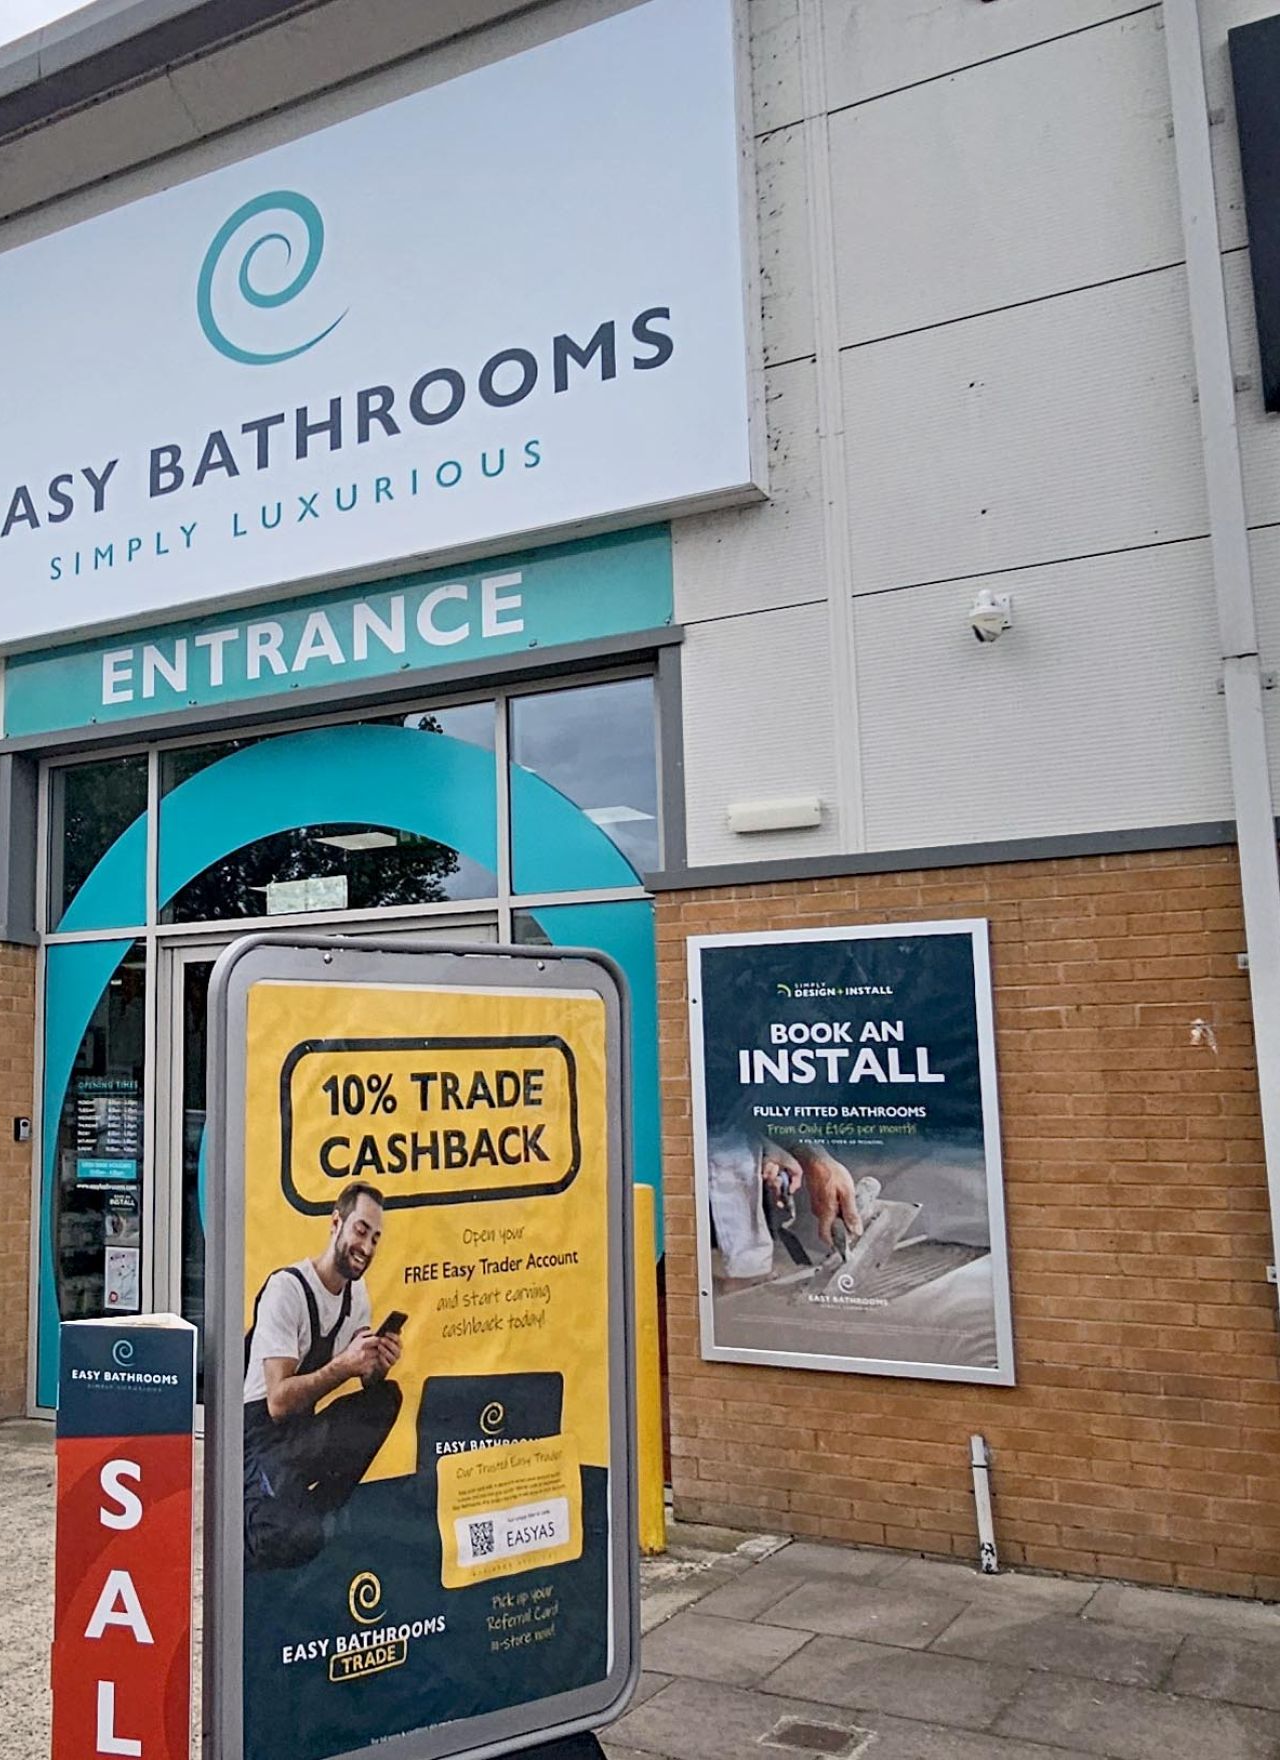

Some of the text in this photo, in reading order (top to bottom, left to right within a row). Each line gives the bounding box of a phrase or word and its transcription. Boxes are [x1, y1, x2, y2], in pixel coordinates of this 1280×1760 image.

[149, 306, 675, 499] BATHROOMS
[50, 440, 543, 580] SIMPLY LUXURIOUS
[102, 572, 525, 705] ENTRANCE
[770, 1021, 904, 1044] BOOK AN
[739, 1047, 945, 1084] INSTALL
[322, 1069, 545, 1116] 10% TRADE
[754, 1106, 927, 1118] FULLY FITTED BATHROOMS
[767, 1124, 796, 1135] From
[857, 1124, 876, 1136] per
[320, 1124, 550, 1178] CASHBACK
[463, 1226, 525, 1247] Open your
[404, 1251, 578, 1284] FREE Easy Trader Account
[437, 1282, 551, 1311] and start earning
[442, 1313, 503, 1338] cashback
[72, 1369, 178, 1385] EASY BATHROOMS
[436, 1441, 466, 1454] EASY
[282, 1615, 446, 1665] EASY BATHROOMS
[341, 1644, 397, 1675] TRADE
